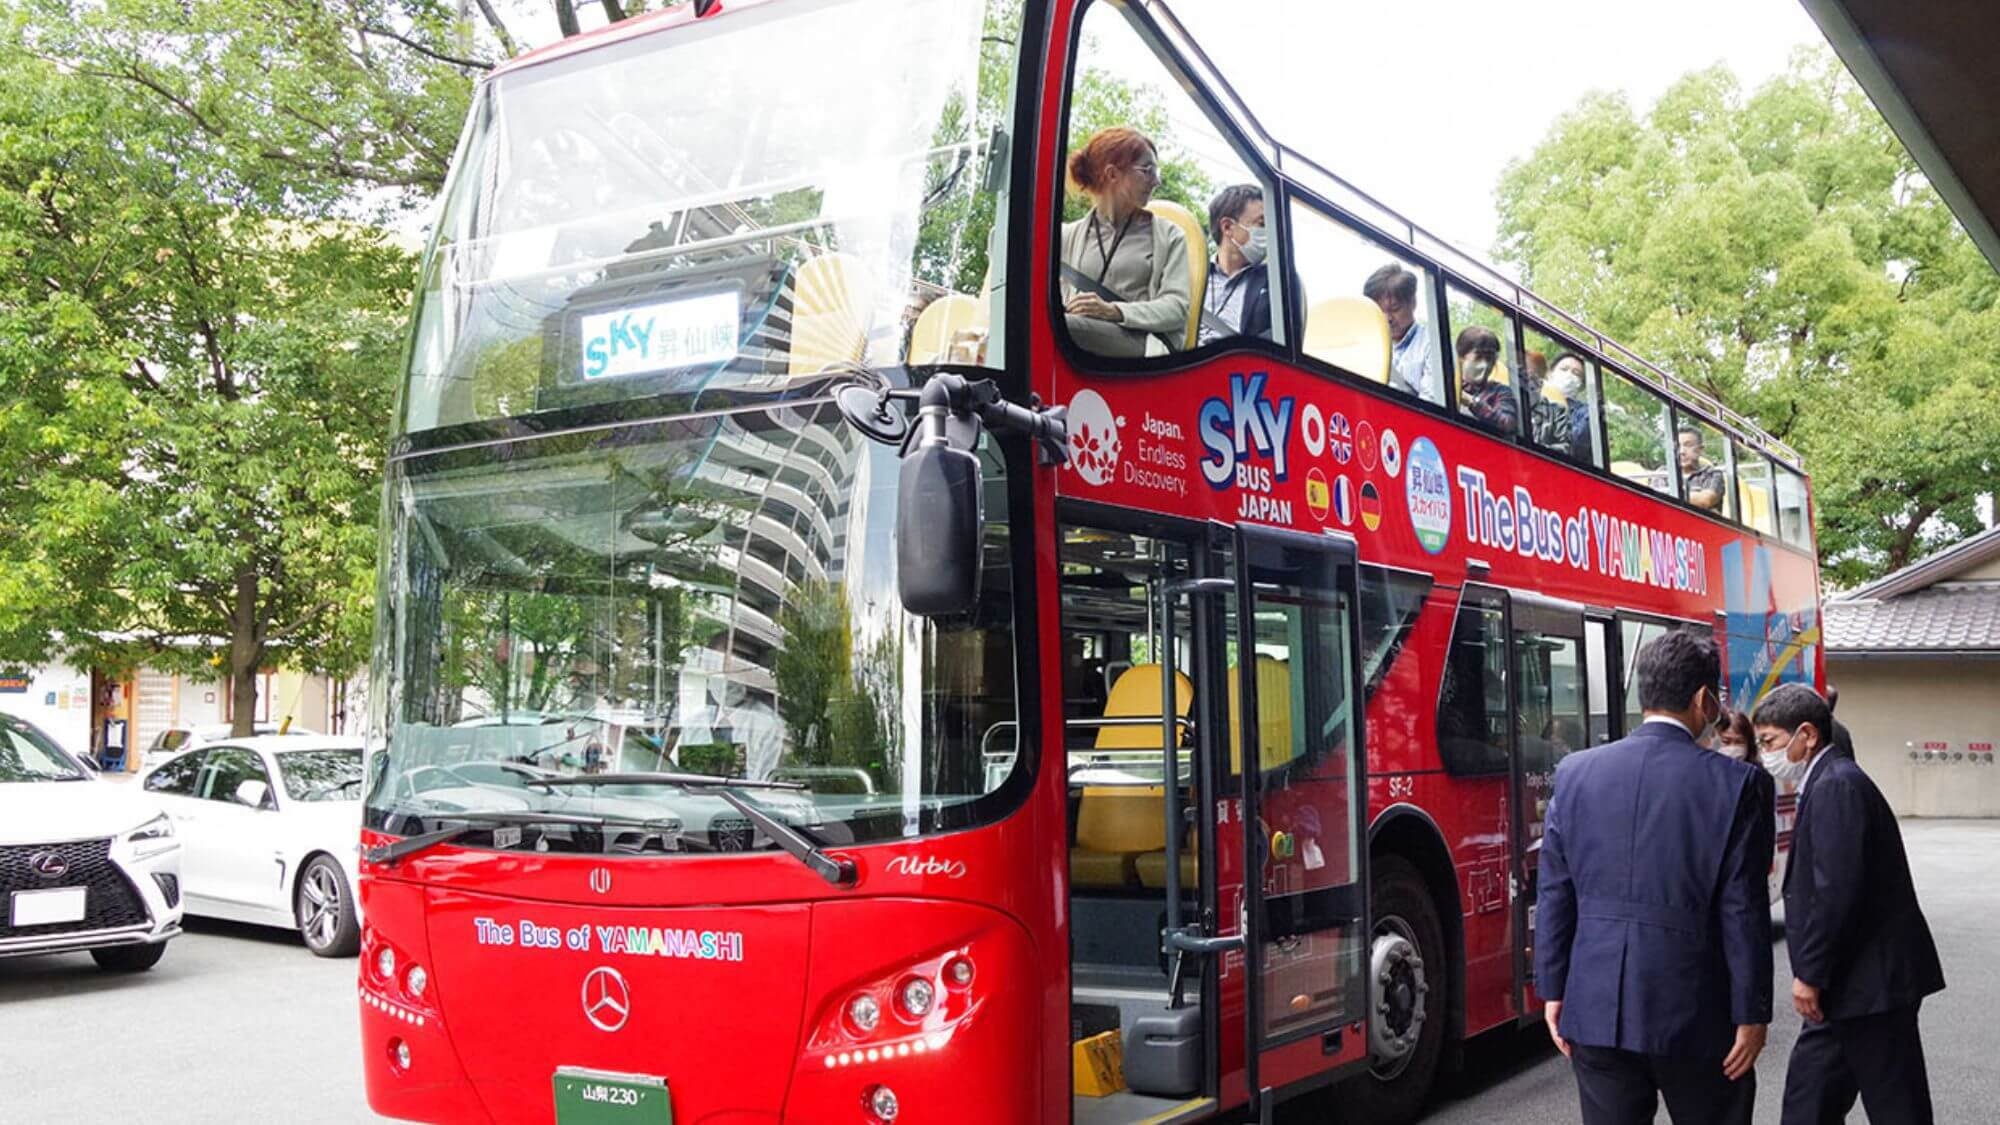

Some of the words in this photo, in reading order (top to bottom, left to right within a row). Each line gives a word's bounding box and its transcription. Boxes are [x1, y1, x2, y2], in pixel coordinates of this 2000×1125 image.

[586, 314, 656, 377] SKY
[658, 321, 735, 358] 昇仙峡
[1142, 411, 1185, 440] Japan.
[1199, 372, 1295, 491] SKY
[1138, 438, 1186, 470] Endless
[1123, 460, 1188, 498] Discovery.
[1235, 461, 1272, 493] BUS
[1238, 493, 1293, 525] JAPAN
[1457, 464, 1515, 552] The
[1513, 485, 1564, 564] Bus
[1565, 506, 1590, 571] of
[1591, 509, 1706, 596] YAMANASHI
[1389, 776, 1413, 798] SF-2
[885, 855, 966, 879] Urbis
[474, 917, 513, 945] The
[519, 920, 562, 948] Bus
[566, 924, 590, 950] of
[597, 926, 743, 961] YAMANASHI
